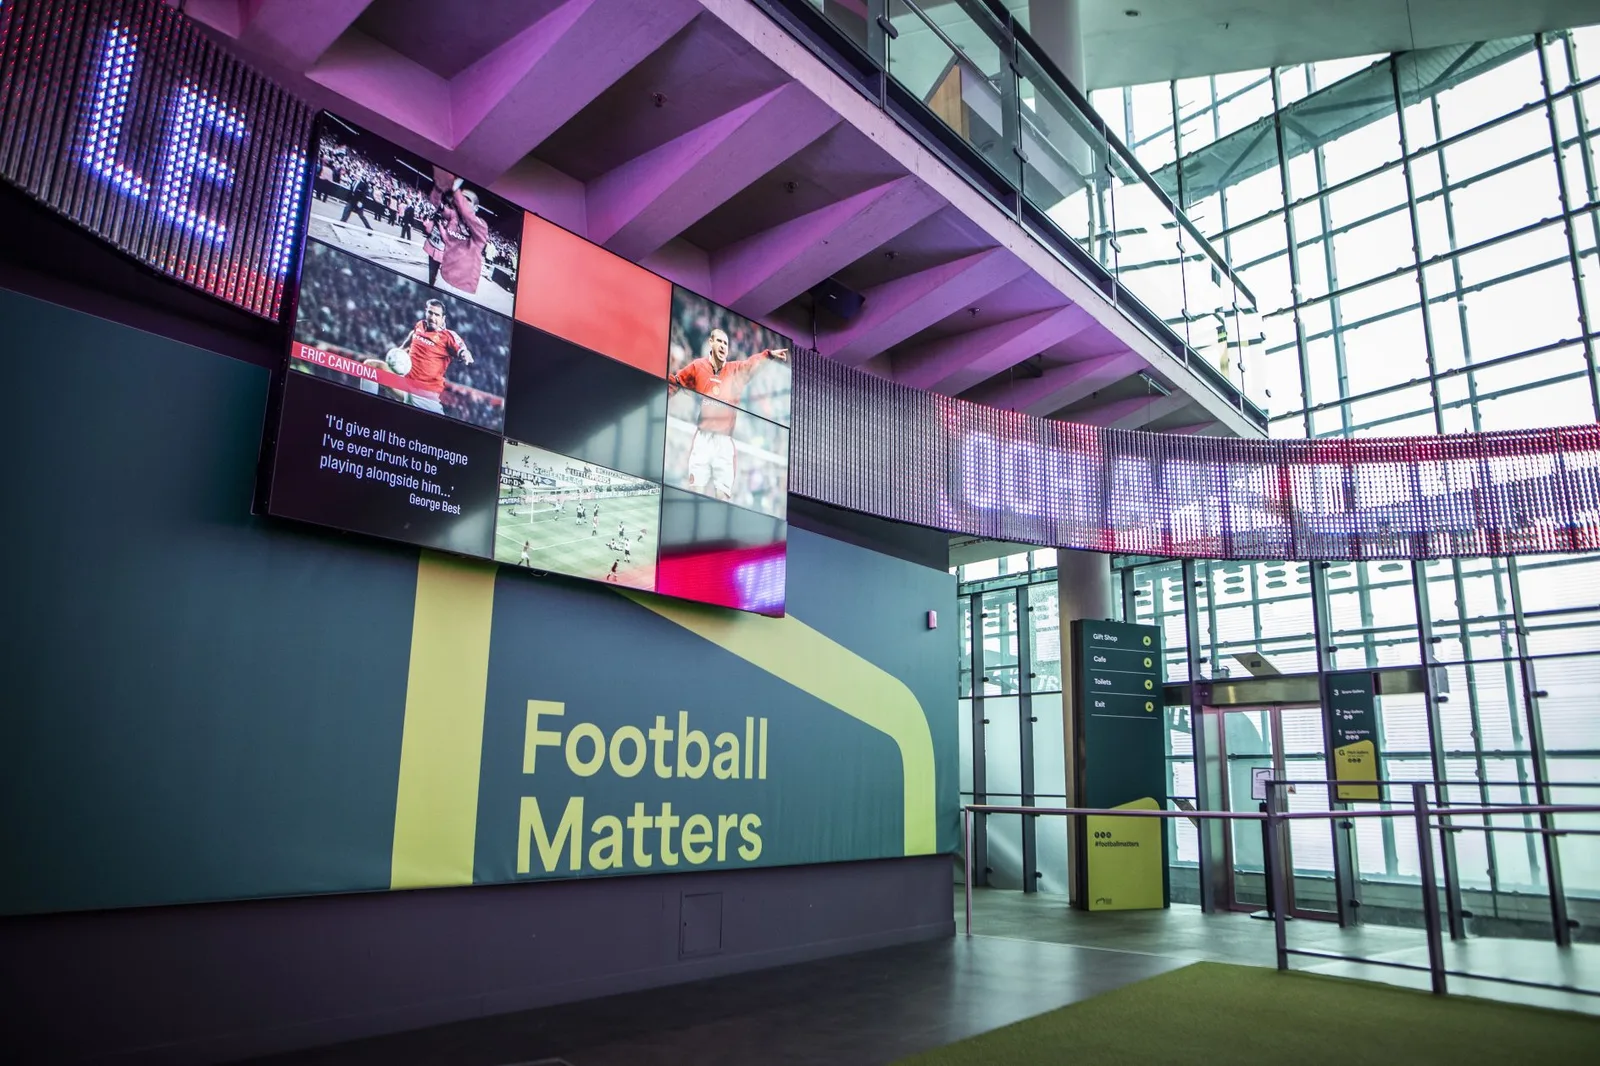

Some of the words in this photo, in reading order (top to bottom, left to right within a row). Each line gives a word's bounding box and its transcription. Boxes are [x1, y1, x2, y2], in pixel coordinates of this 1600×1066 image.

[300, 346, 326, 366] ERIC
[328, 355, 378, 382] CANTONA
[322, 434, 344, 450] I've
[347, 440, 373, 458] ever
[376, 446, 408, 468] drunk
[411, 458, 422, 472] to
[424, 462, 438, 476] be
[346, 422, 370, 438] give
[373, 430, 386, 442] all
[388, 434, 406, 448] the
[408, 439, 468, 466] champagne
[320, 454, 364, 479] playing
[366, 467, 419, 490] alongside
[409, 493, 440, 512] George
[442, 500, 461, 516] Best
[1104, 634, 1118, 642] Shop
[1094, 678, 1112, 686] Toilets
[522, 699, 768, 780] Football
[517, 796, 763, 874] Matters
